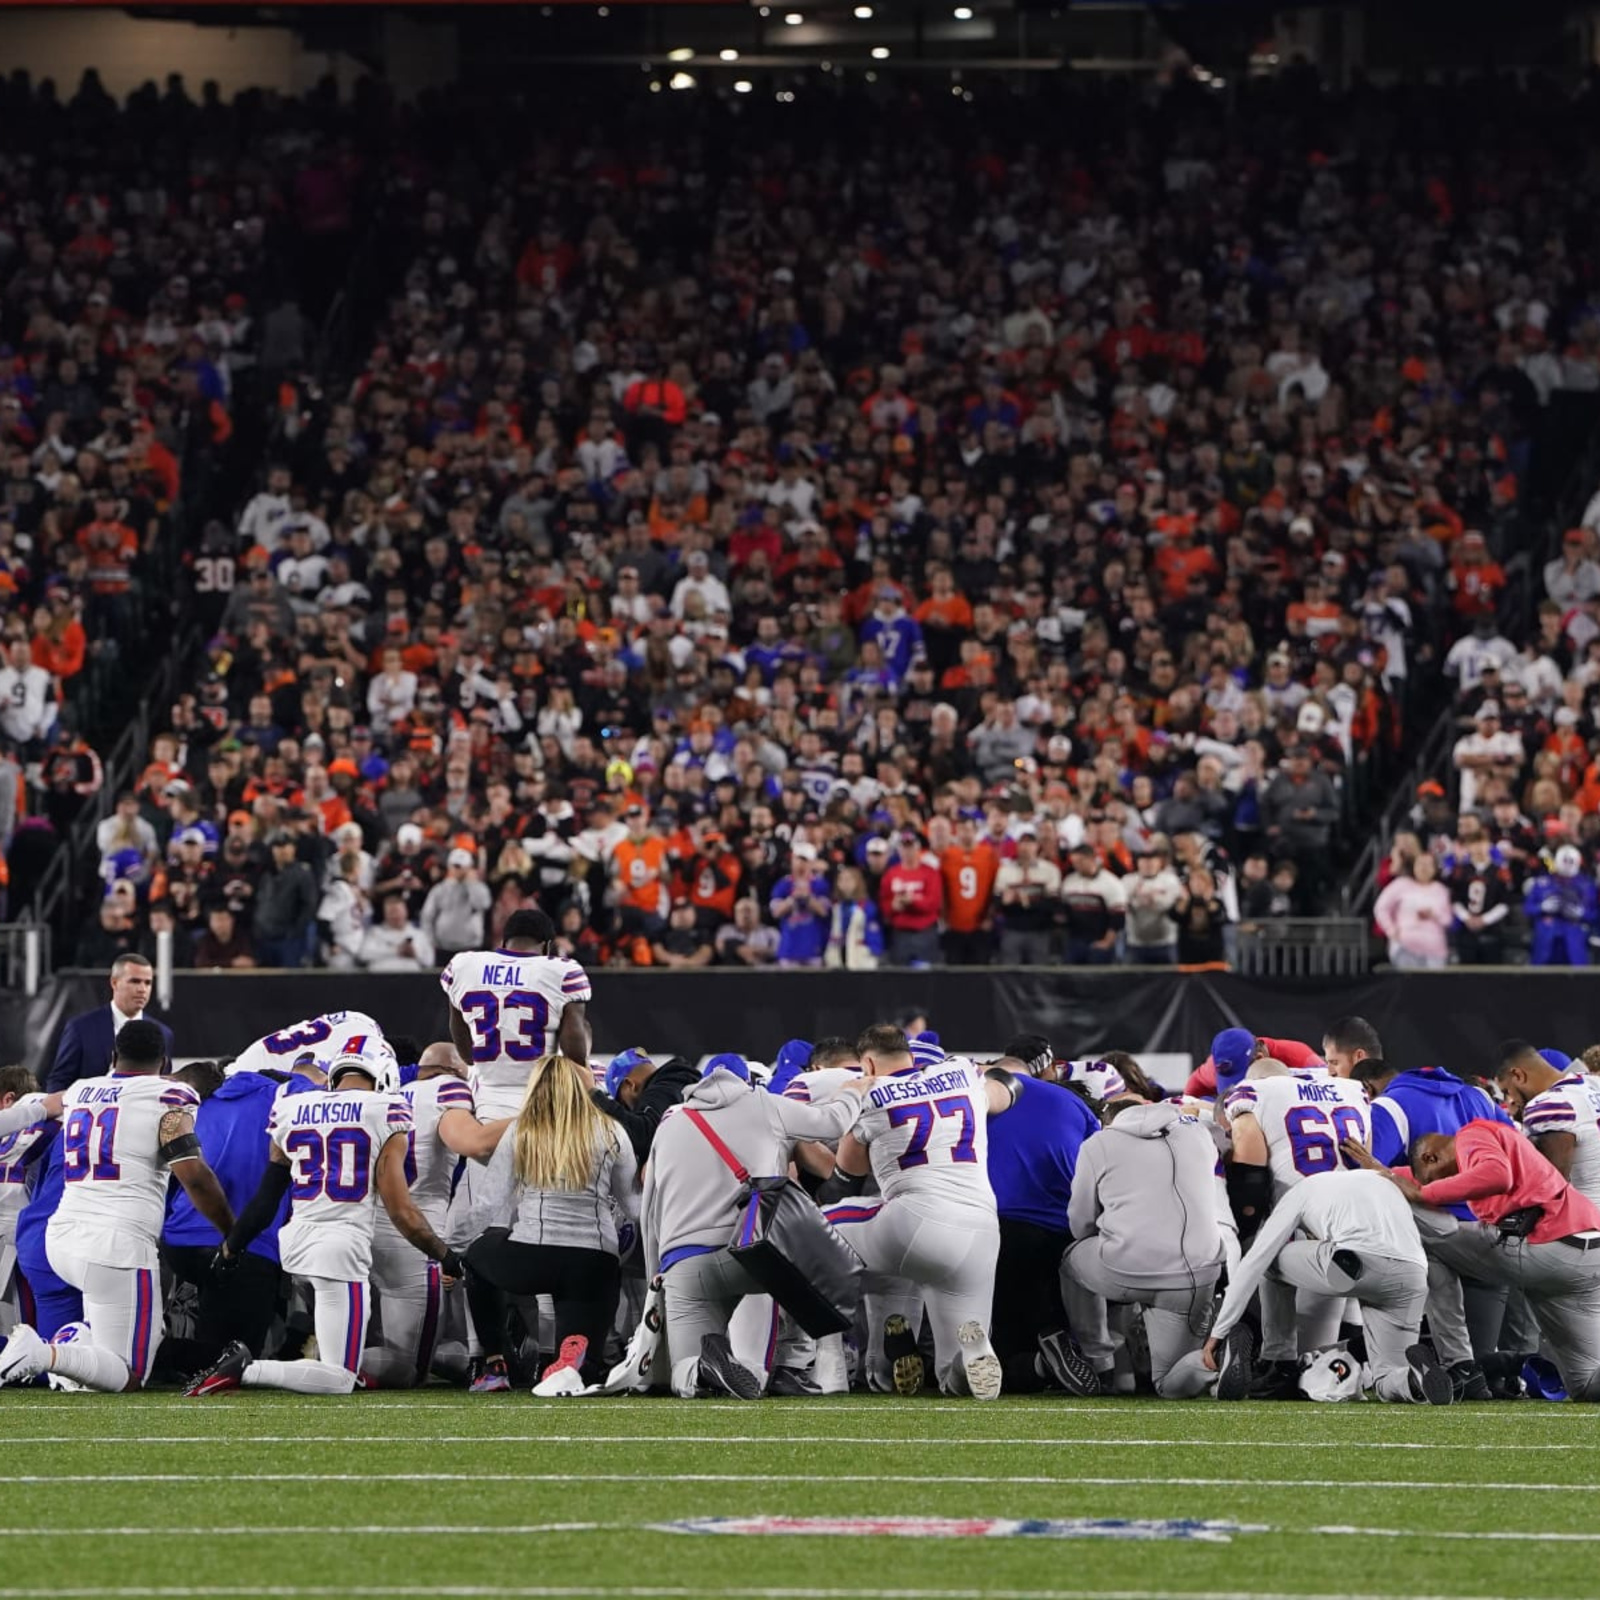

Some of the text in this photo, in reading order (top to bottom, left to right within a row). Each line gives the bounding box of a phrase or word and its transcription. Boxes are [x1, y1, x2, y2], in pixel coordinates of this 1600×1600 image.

[194, 557, 236, 592] 30
[11, 681, 26, 708] 9
[959, 866, 977, 900] 9
[1468, 879, 1487, 914] 9
[482, 965, 524, 987] NEAL
[460, 990, 549, 1062] 33
[870, 1069, 970, 1108] QUESSENBERRY
[1297, 1084, 1344, 1102] MORSE
[291, 1102, 364, 1126] JACKSON
[64, 1107, 121, 1183] 91
[887, 1095, 978, 1171] 77
[1284, 1106, 1366, 1177] 60
[286, 1127, 372, 1203] 30
